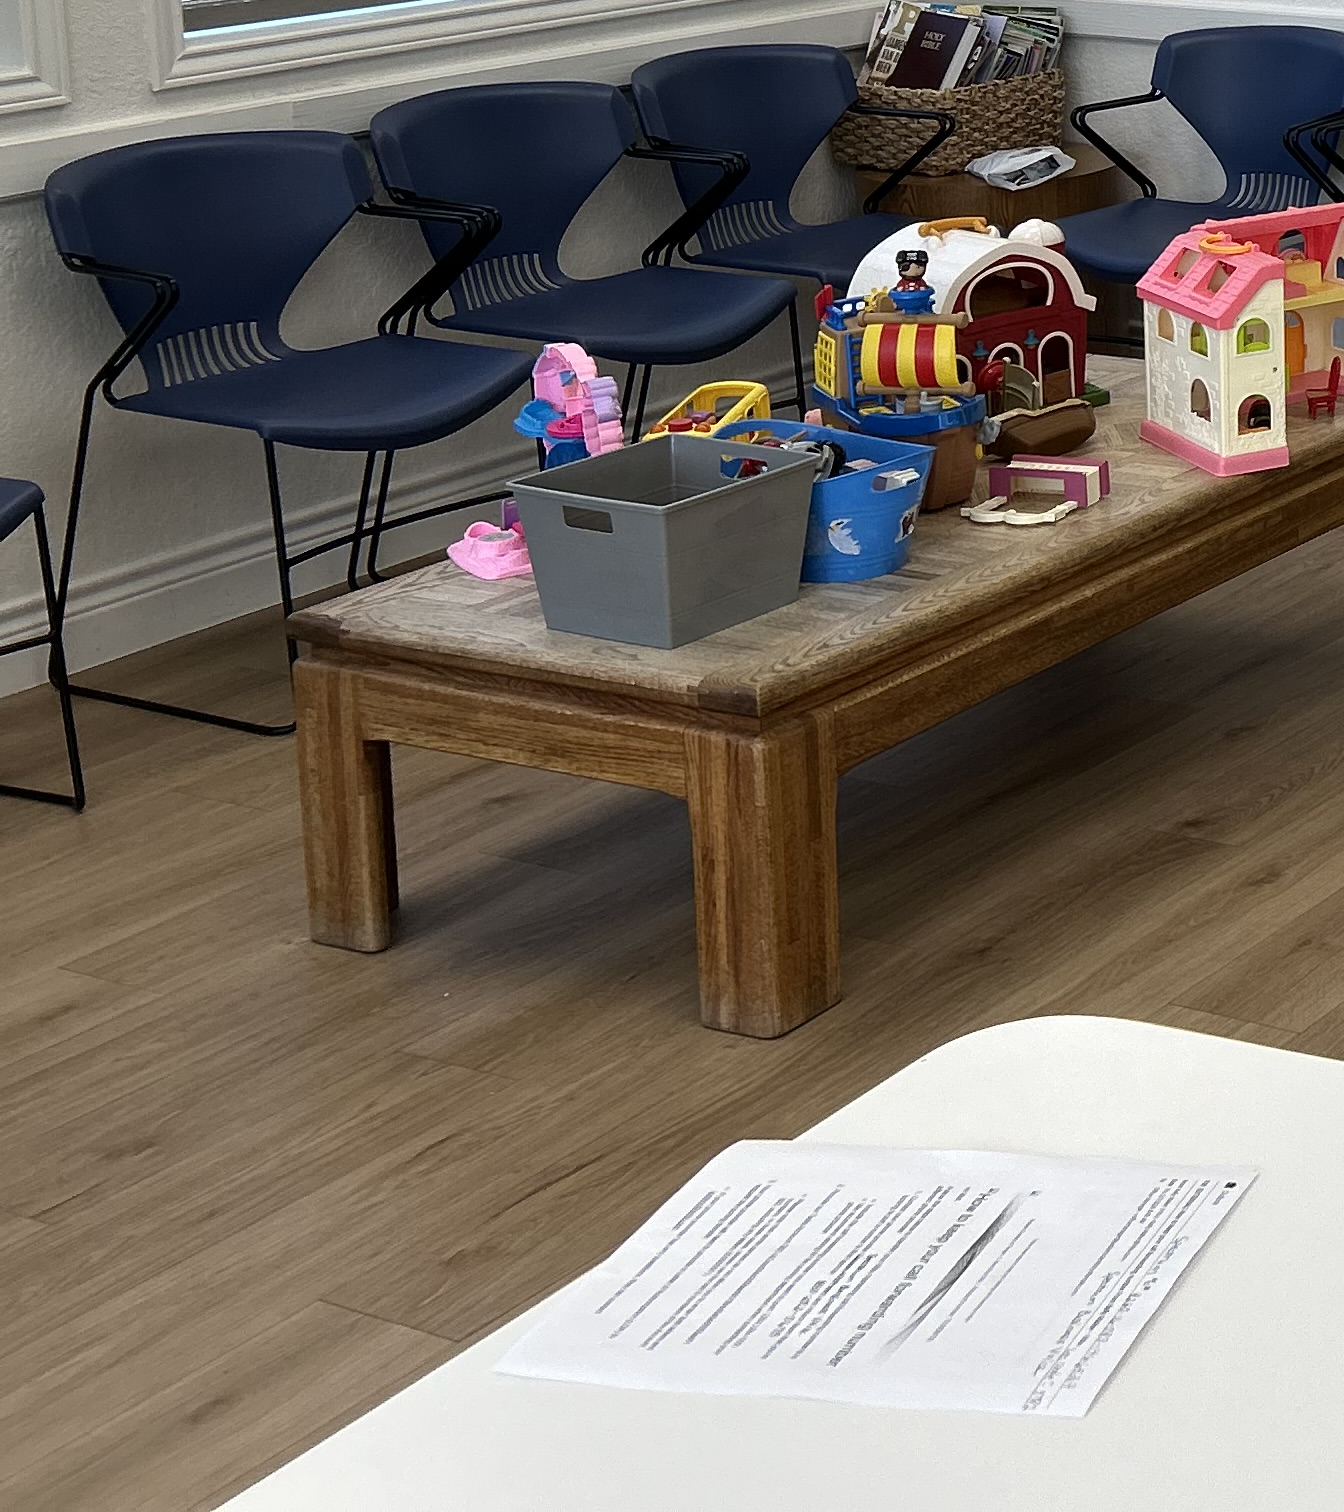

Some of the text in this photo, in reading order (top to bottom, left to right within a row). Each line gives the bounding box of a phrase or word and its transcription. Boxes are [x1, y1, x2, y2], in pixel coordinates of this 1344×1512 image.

[924, 31, 946, 41] HOLY
[962, 1193, 991, 1212] How
[954, 1213, 973, 1222] to
[933, 1223, 964, 1242] keep
[915, 1244, 944, 1262] your
[902, 1264, 928, 1279] call
[855, 1281, 913, 1330] forwarding
[824, 1331, 869, 1367] number
